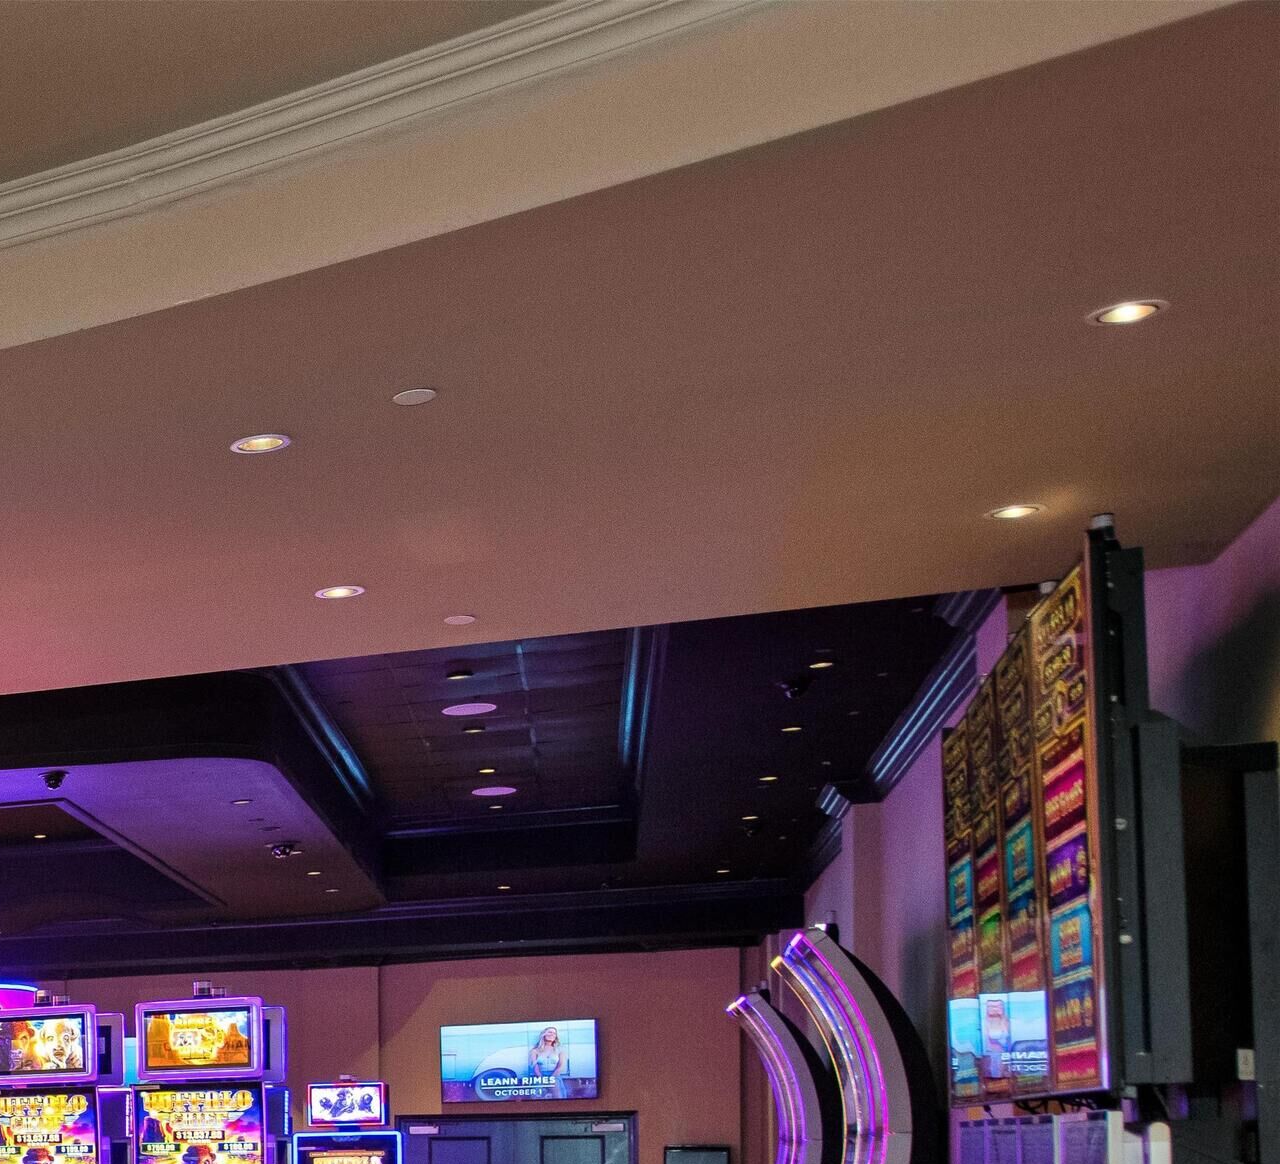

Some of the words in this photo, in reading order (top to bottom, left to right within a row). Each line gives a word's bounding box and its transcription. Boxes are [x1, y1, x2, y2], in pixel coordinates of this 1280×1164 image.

[481, 1078, 518, 1086] LEANN
[522, 1076, 556, 1085] RIMES
[495, 1089, 536, 1097] OCTOBER
